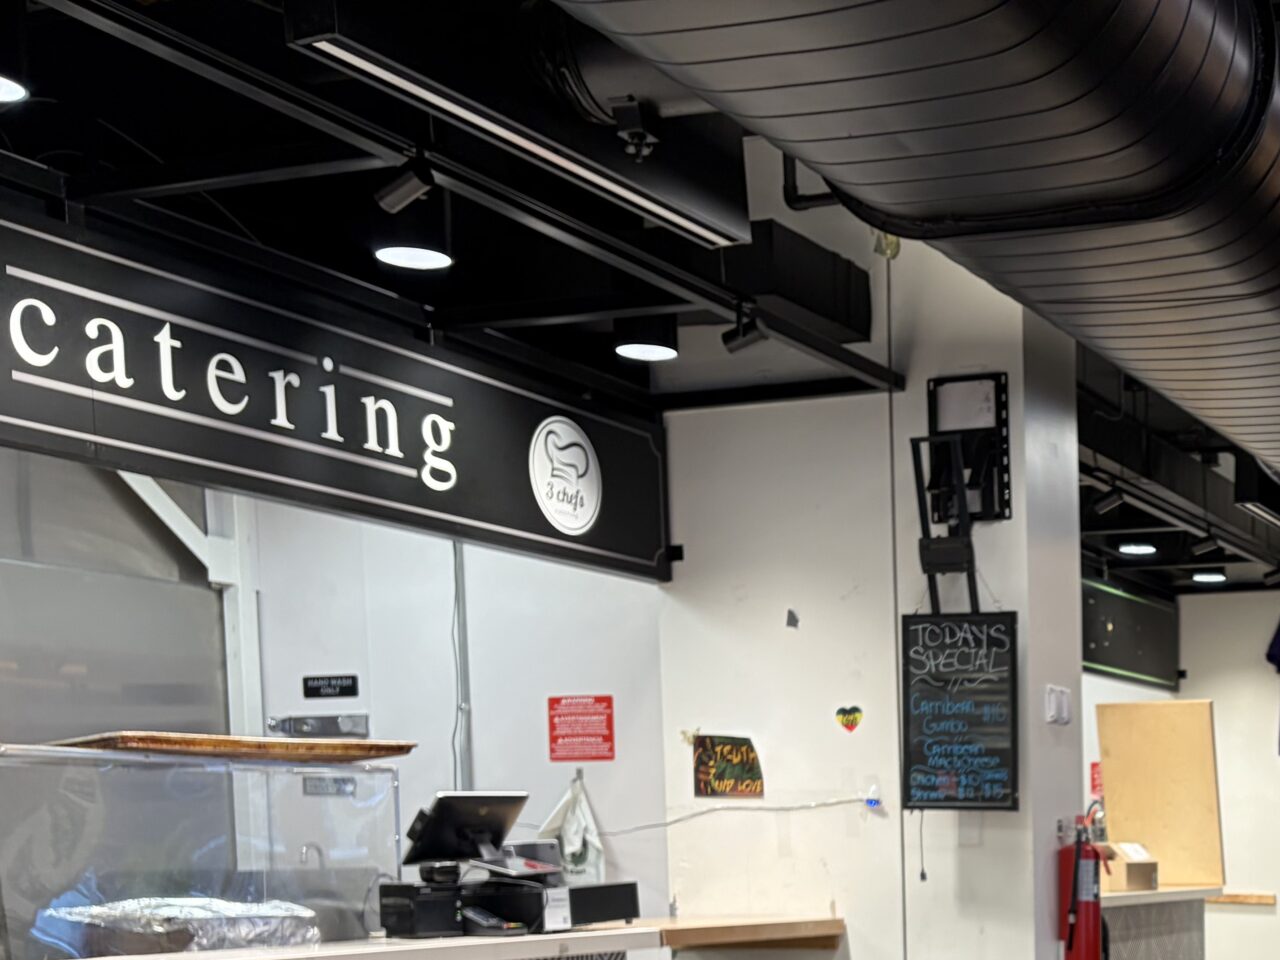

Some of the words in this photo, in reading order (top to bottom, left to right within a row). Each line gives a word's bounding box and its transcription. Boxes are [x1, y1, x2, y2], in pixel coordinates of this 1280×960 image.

[9, 297, 457, 491] catering
[545, 481, 555, 500] 3
[556, 486, 585, 512] chefs
[909, 622, 1010, 653] TODAYS
[909, 645, 1009, 674] SPECIAL
